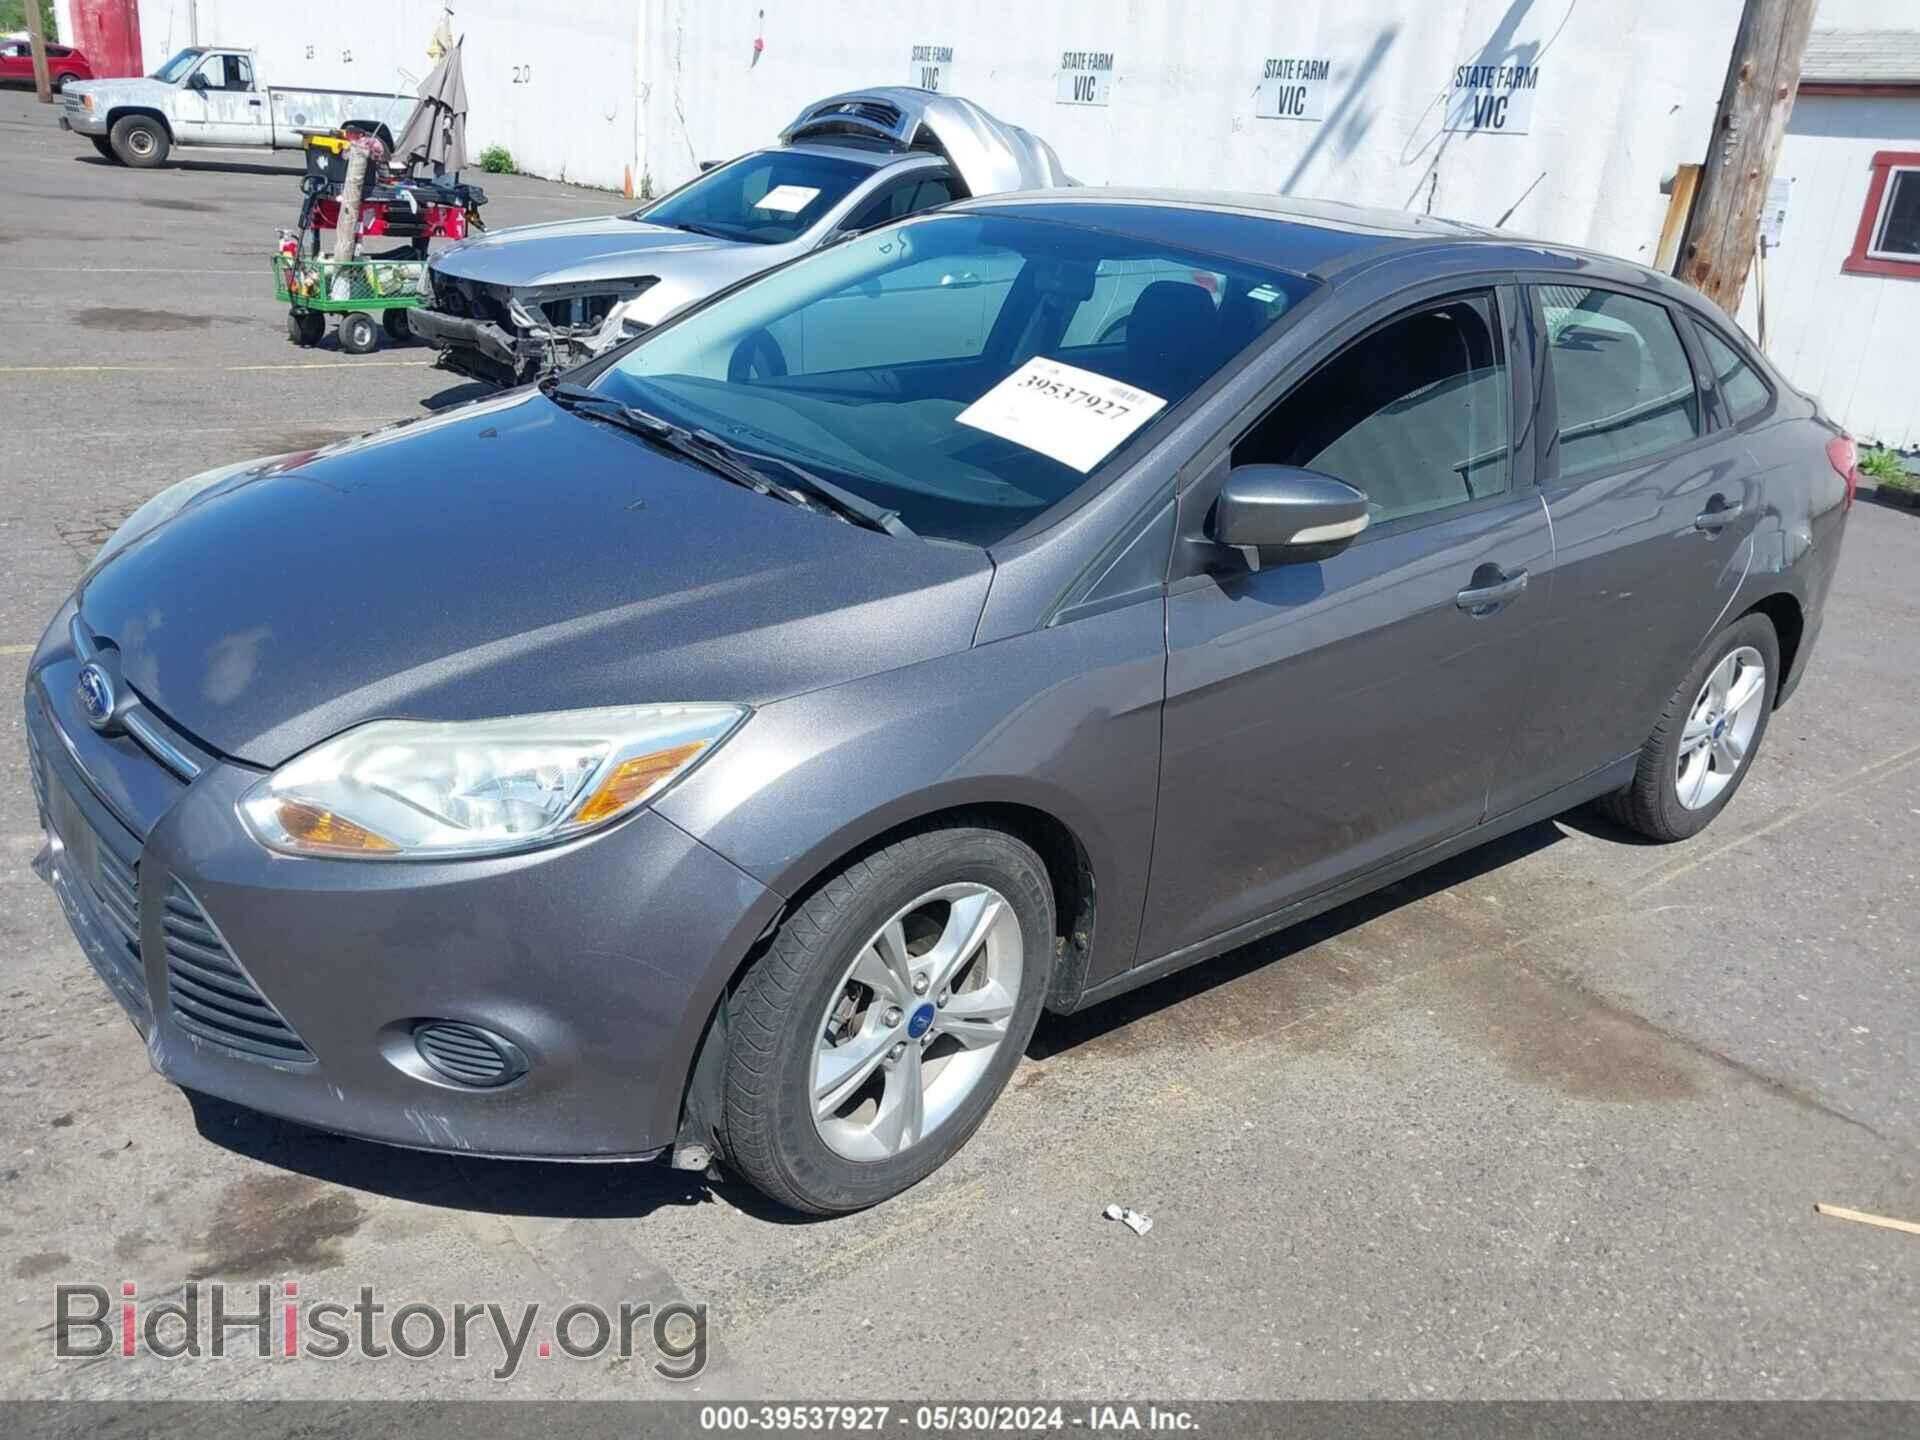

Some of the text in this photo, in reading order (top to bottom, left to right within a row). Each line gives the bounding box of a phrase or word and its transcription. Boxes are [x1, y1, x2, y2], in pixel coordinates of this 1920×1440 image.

[912, 46, 953, 63] STATE FARM
[1062, 52, 1114, 71] STATE FARM
[512, 64, 530, 84] 20
[921, 67, 940, 90] VIC
[1265, 59, 1330, 80] STATE FARM
[1456, 65, 1539, 89] STATE FARM
[1074, 75, 1096, 102] VIC
[1279, 85, 1306, 115] VIC
[1473, 95, 1509, 128] VIC
[1017, 374, 1131, 420] 39537927
